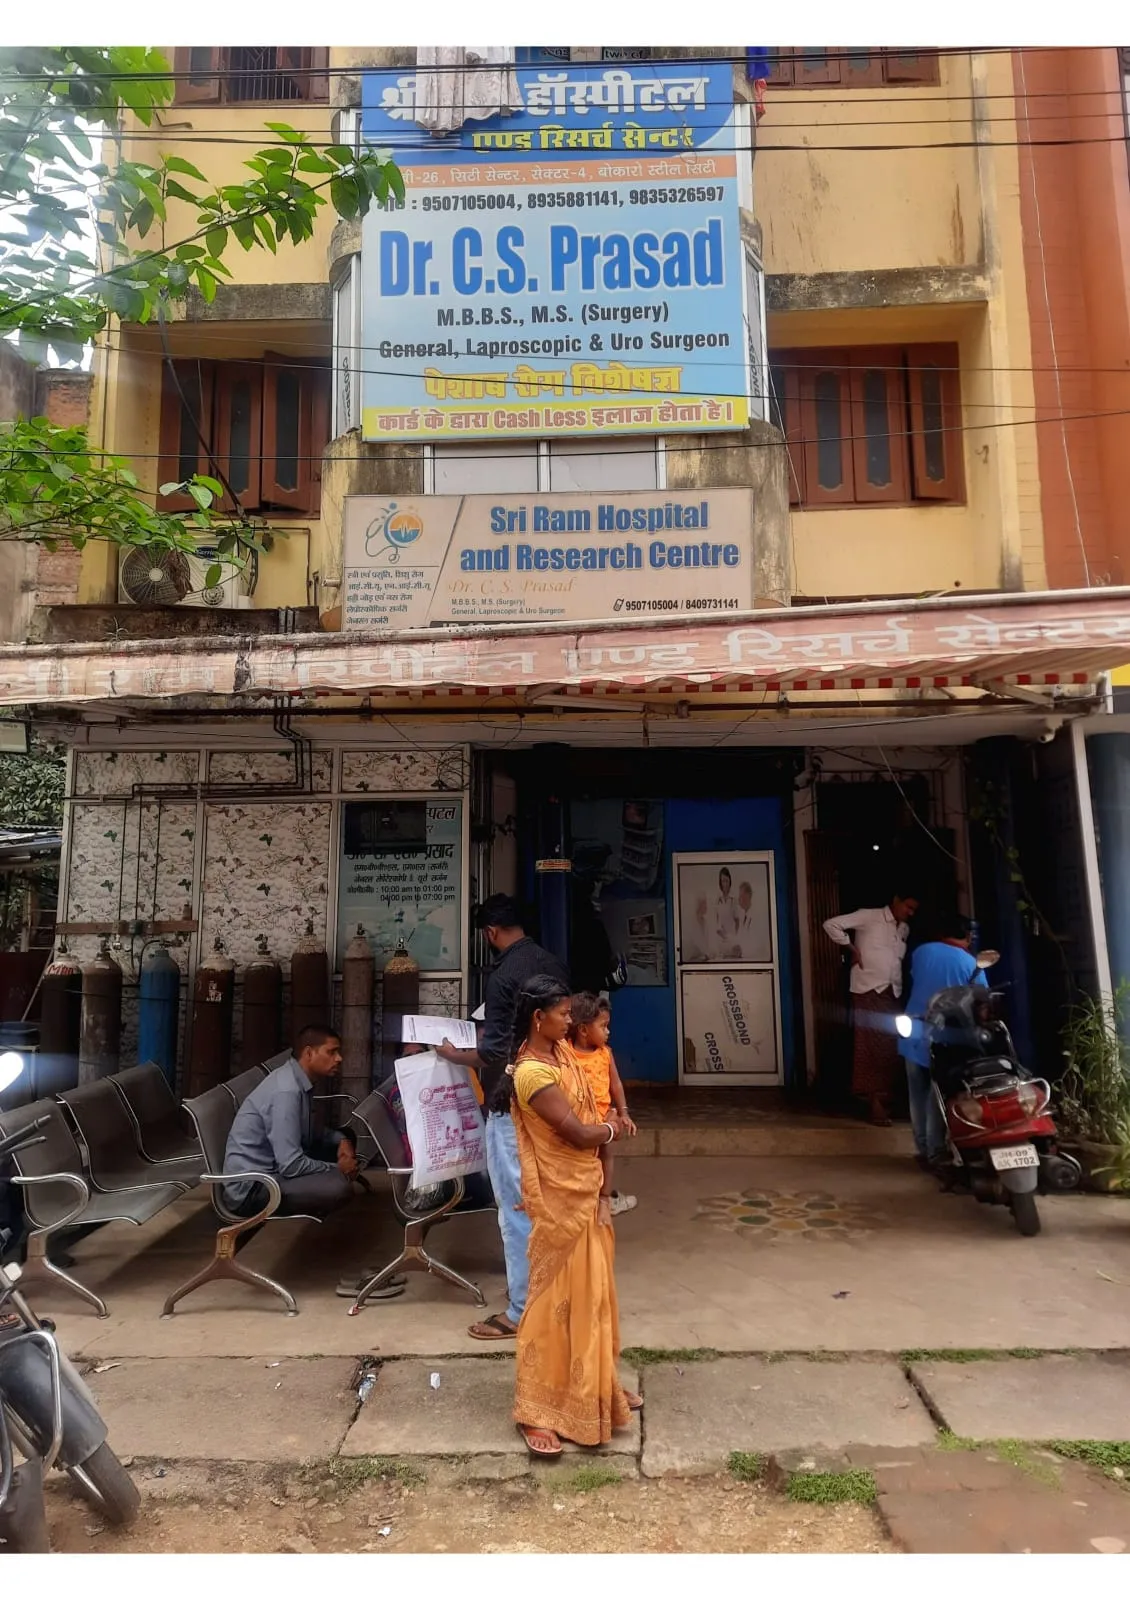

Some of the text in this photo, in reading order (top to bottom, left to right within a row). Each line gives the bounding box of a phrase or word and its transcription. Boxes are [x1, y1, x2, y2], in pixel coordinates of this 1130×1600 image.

[524, 70, 710, 119] हॉस्पीटल
[539, 122, 614, 151] रिसर्च
[598, 162, 642, 178] बोकारो
[422, 195, 522, 213] 9507105004,
[527, 191, 625, 210] 8935881141,
[629, 187, 724, 206] 9835326597
[379, 219, 724, 297] Dr. C.S. Prasad
[437, 302, 669, 328] M.B.B.S., M.S. (Surgery)
[379, 332, 730, 359] General, Laproscopic & Uro Surgeon
[424, 368, 508, 400] पेशाब
[512, 364, 566, 397] रोग
[378, 408, 419, 431] कार्ड
[423, 408, 445, 430] के
[493, 409, 541, 429] Cash
[545, 408, 587, 427] Less
[592, 405, 652, 427] इलाज
[657, 401, 702, 422] होता
[490, 501, 709, 535] Sri Ram Hospital
[460, 541, 740, 572] and Research Centre
[449, 577, 577, 595] Dr. C. S. Prasad
[625, 599, 678, 611] 9507105004
[685, 598, 739, 610] 8409731141
[721, 617, 914, 663] रिसर्च
[722, 975, 751, 1047] CROSSBOND
[1013, 1156, 1036, 1166] 1702
